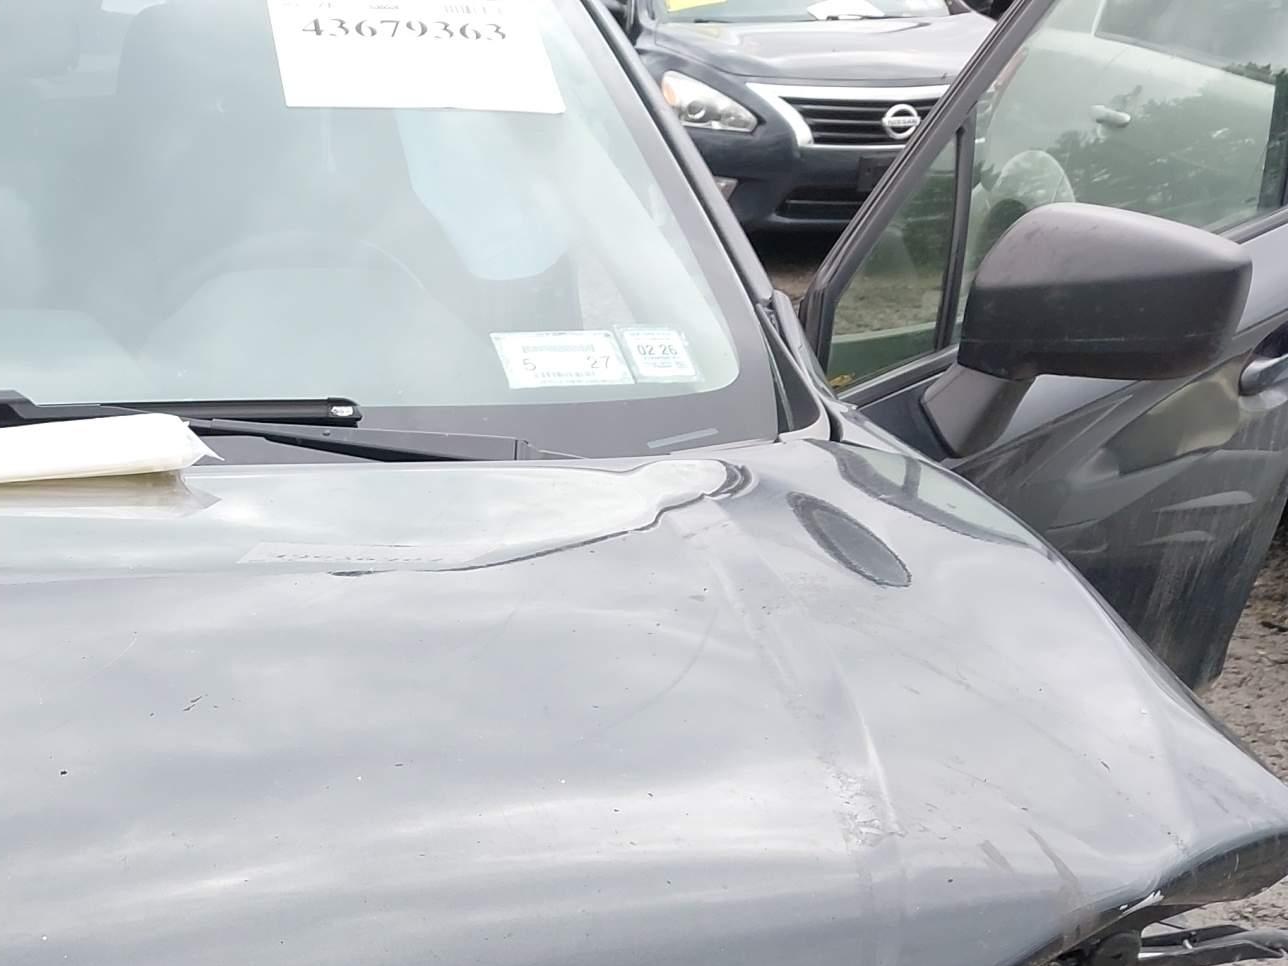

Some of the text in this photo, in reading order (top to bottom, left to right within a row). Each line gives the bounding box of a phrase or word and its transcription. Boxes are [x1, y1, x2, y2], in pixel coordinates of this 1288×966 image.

[302, 17, 507, 41] 43679363
[637, 344, 678, 356] 02 26
[522, 355, 611, 372] 5 27
